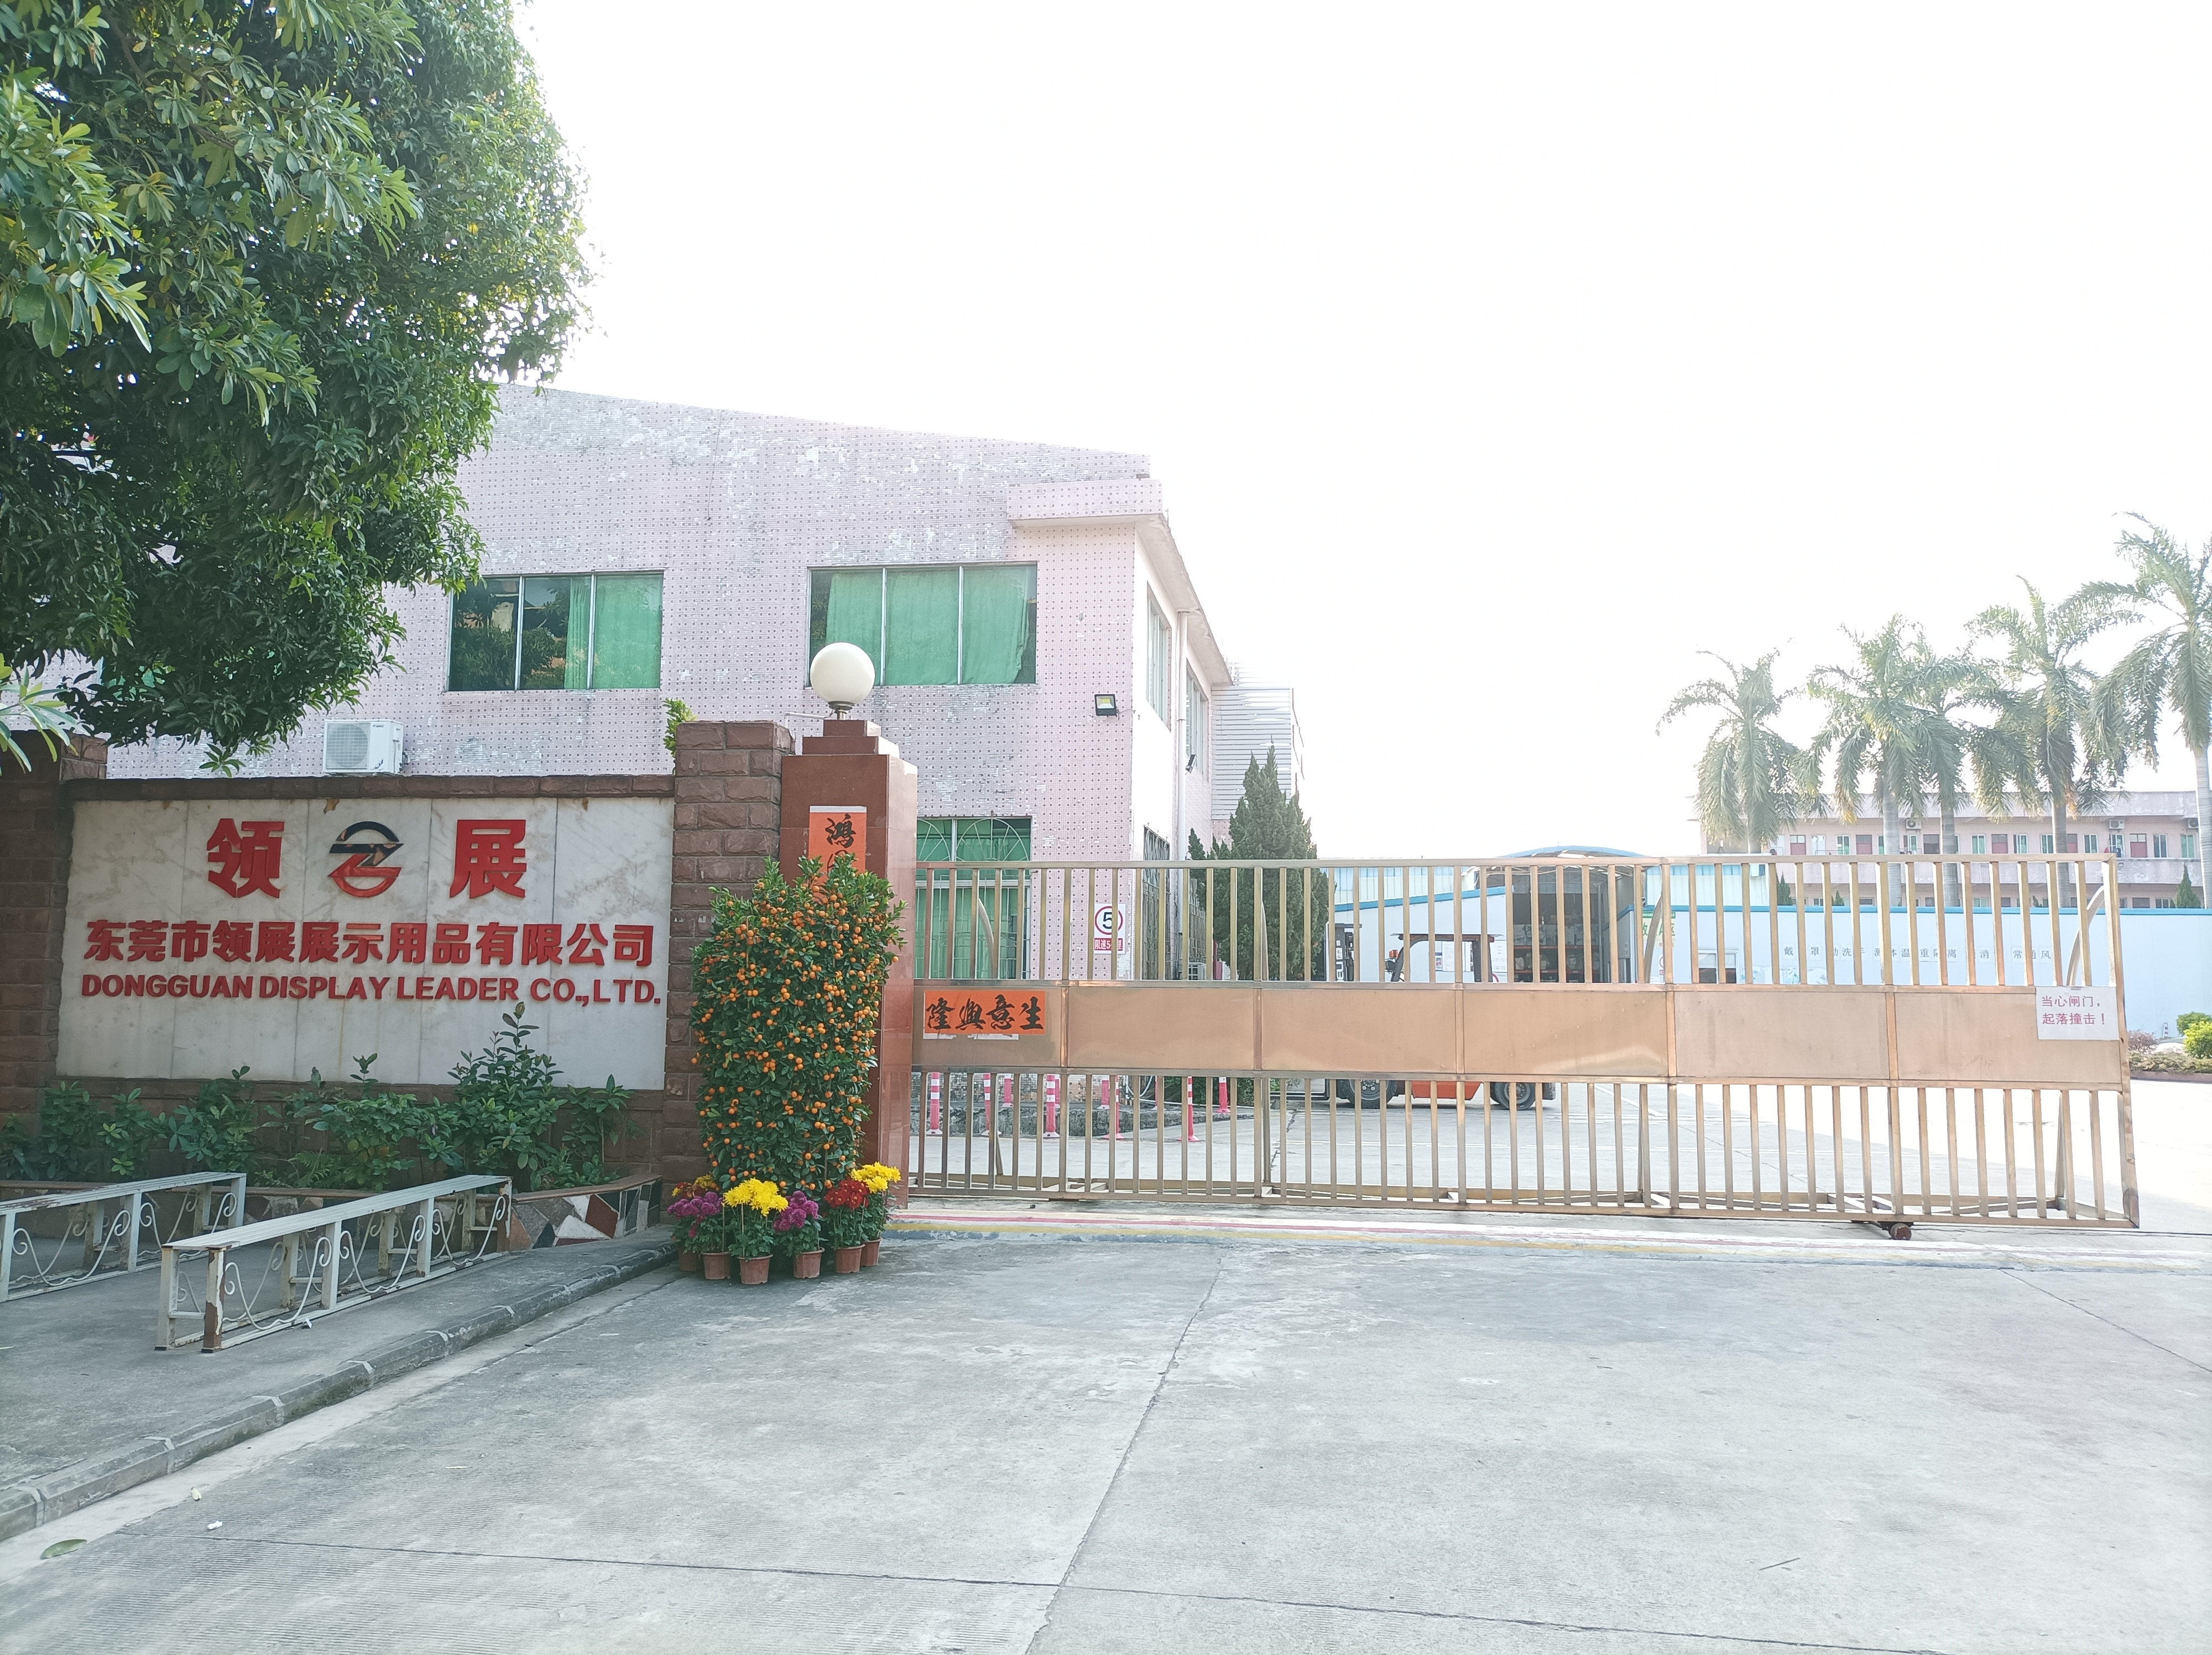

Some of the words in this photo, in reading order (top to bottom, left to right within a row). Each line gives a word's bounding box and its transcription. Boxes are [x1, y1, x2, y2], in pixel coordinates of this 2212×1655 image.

[207, 818, 284, 899] 领
[450, 819, 526, 899] 展
[1103, 912, 1113, 929] 5
[84, 919, 654, 967] 东莞市领展展示用品有限公司
[1784, 946, 1819, 956] 戴罩
[82, 974, 253, 998] DONGGUAN
[259, 976, 390, 1000] DISPLAY
[397, 977, 519, 1001] LEADER
